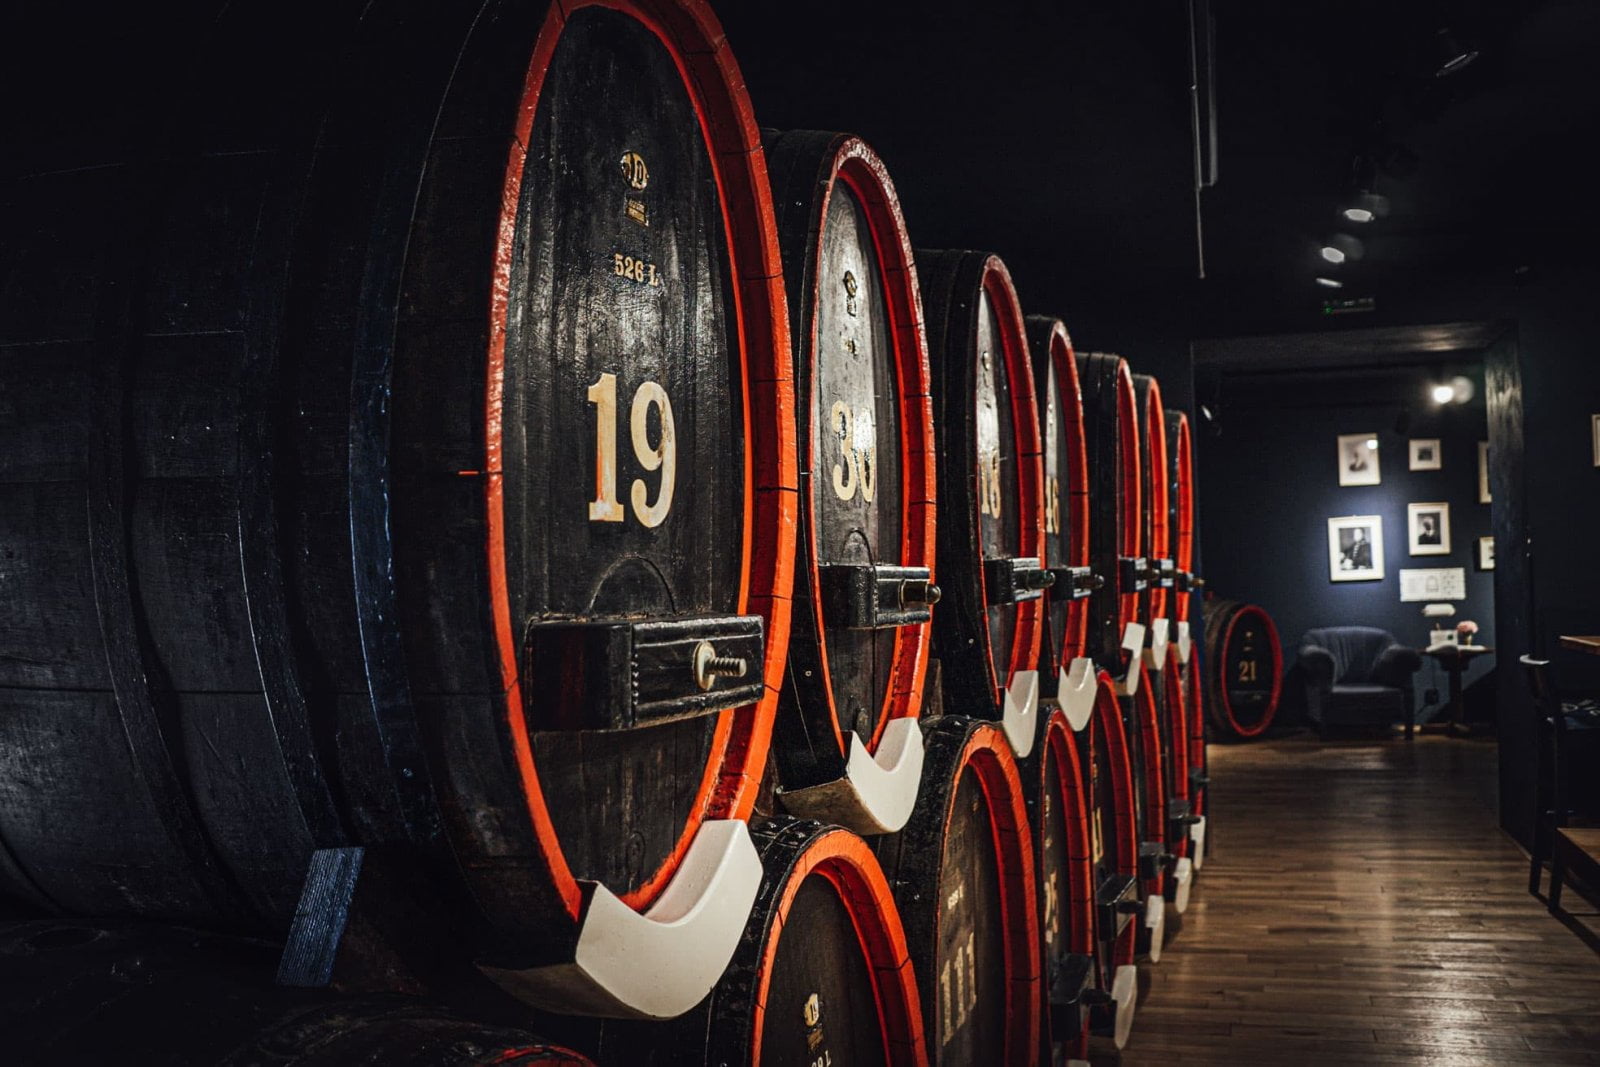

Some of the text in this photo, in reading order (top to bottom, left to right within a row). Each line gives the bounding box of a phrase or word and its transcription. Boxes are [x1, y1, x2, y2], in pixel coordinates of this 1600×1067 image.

[613, 252, 659, 287] 526 L
[588, 373, 676, 528] 19
[831, 400, 875, 503] 30
[1238, 659, 1257, 683] 21
